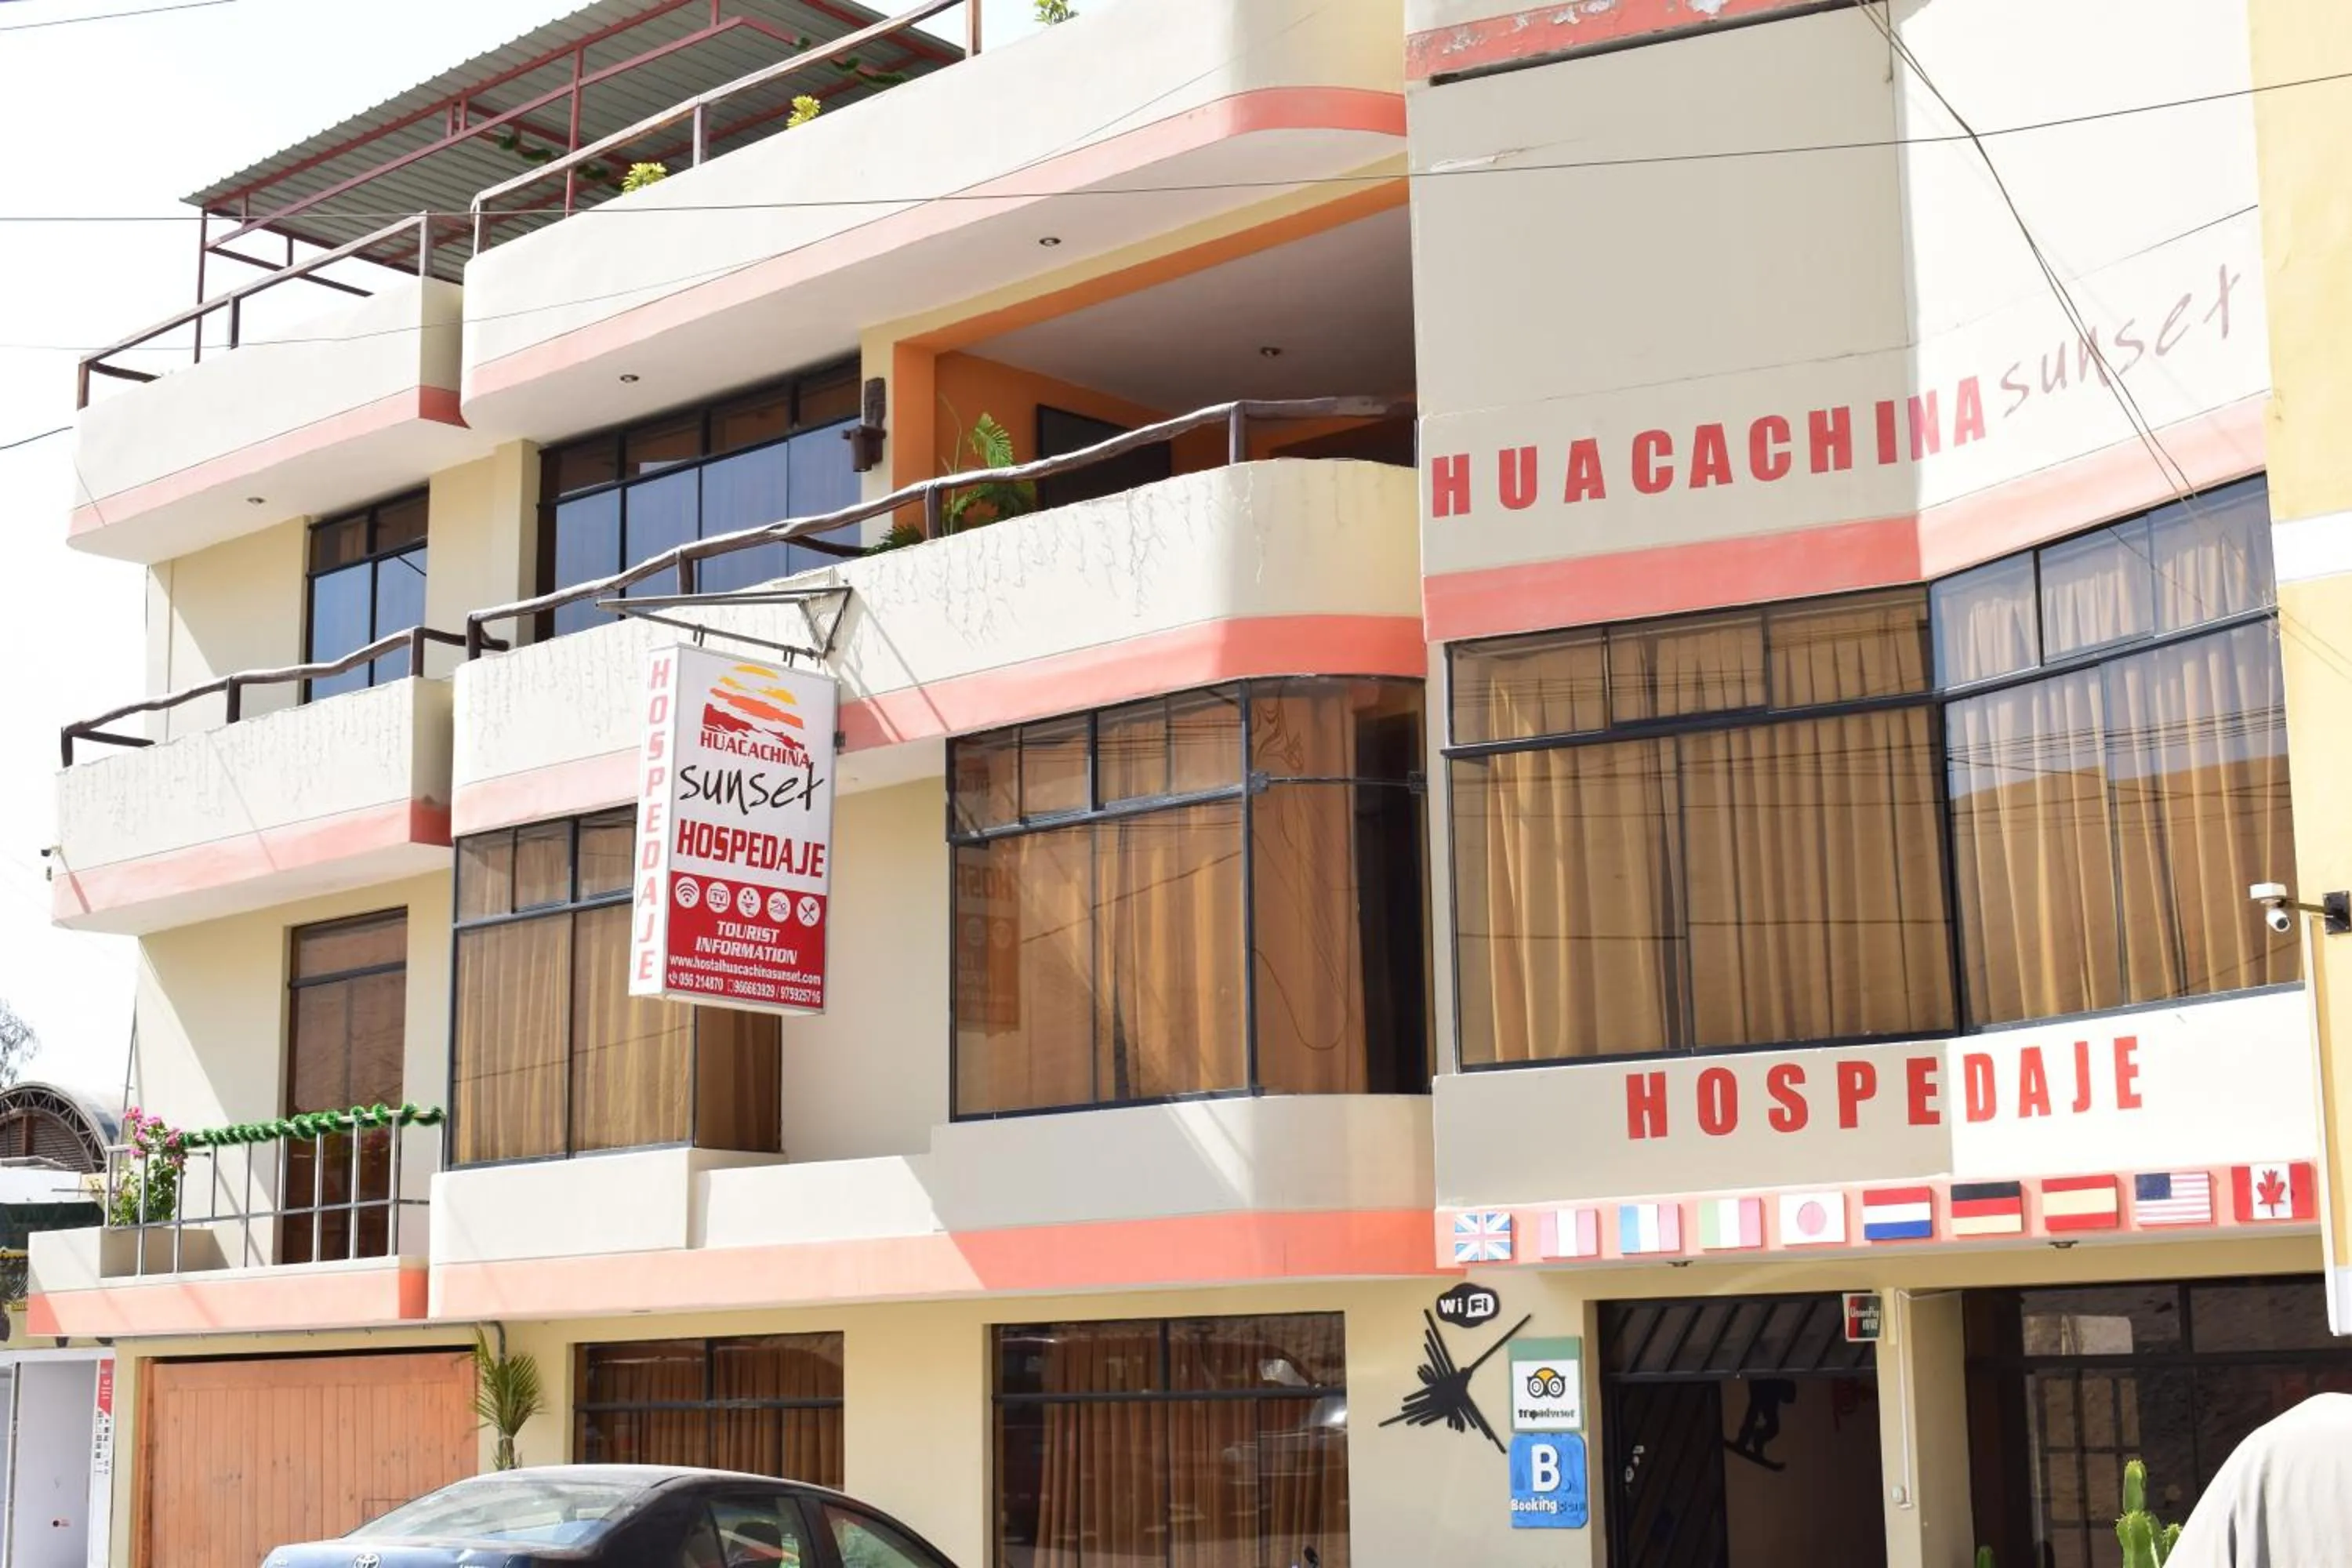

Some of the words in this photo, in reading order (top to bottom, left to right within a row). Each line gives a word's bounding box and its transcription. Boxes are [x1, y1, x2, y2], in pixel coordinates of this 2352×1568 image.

[1430, 377, 1984, 520] HUACACHINA
[2000, 263, 2241, 419] sunset
[699, 728, 811, 771] HUACACHINA
[678, 761, 825, 816] sunset
[637, 657, 671, 982] HOSPEDAJE
[676, 818, 826, 880] HOSPEDAJE
[695, 936, 798, 965] INFORMATION
[716, 920, 780, 944] TOURIST
[669, 954, 822, 985] www.hostalhuacachinasunset.com
[1626, 1036, 2143, 1141] HOSPEDAJE
[1531, 1443, 1561, 1493] B
